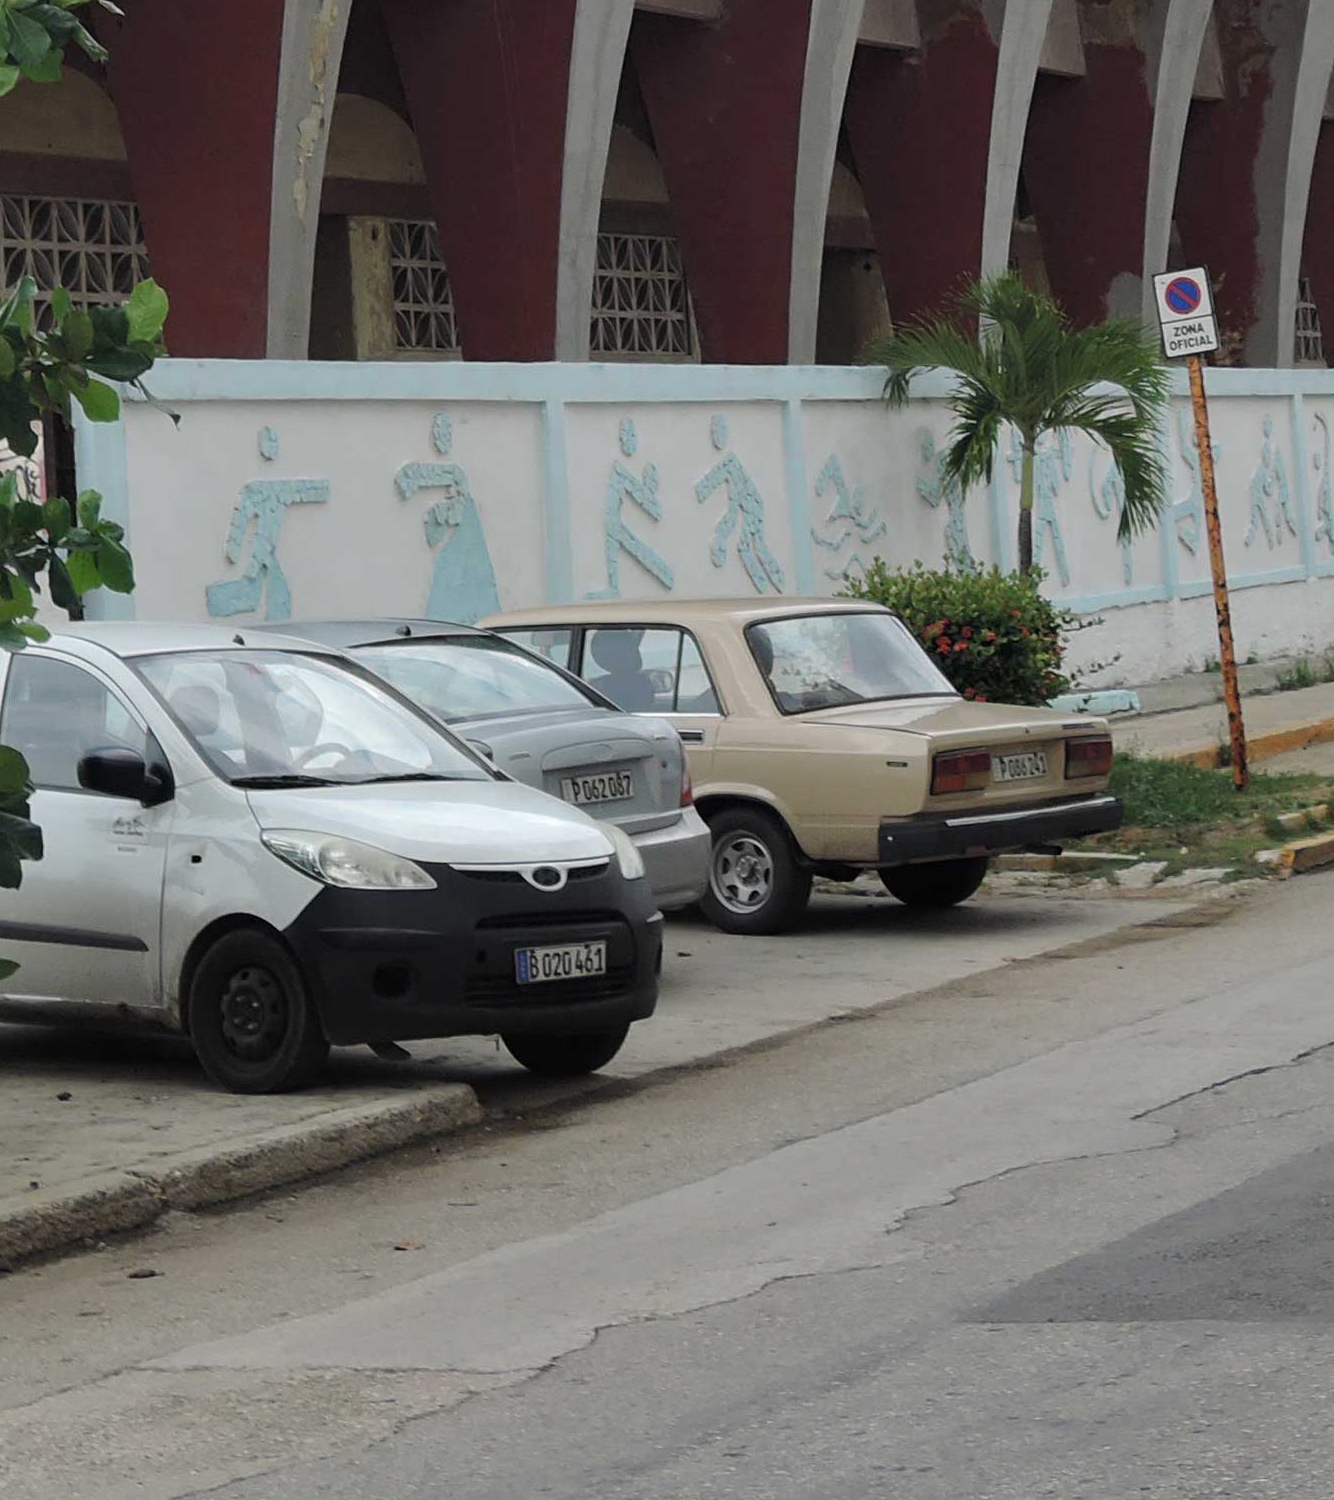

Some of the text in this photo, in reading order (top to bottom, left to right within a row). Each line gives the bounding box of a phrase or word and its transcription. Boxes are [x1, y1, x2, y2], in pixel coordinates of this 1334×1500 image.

[1173, 323, 1204, 337] ZONA
[1169, 335, 1213, 351] OFICIAL
[530, 953, 540, 979] B
[543, 951, 572, 978] 020
[575, 947, 603, 974] 461
